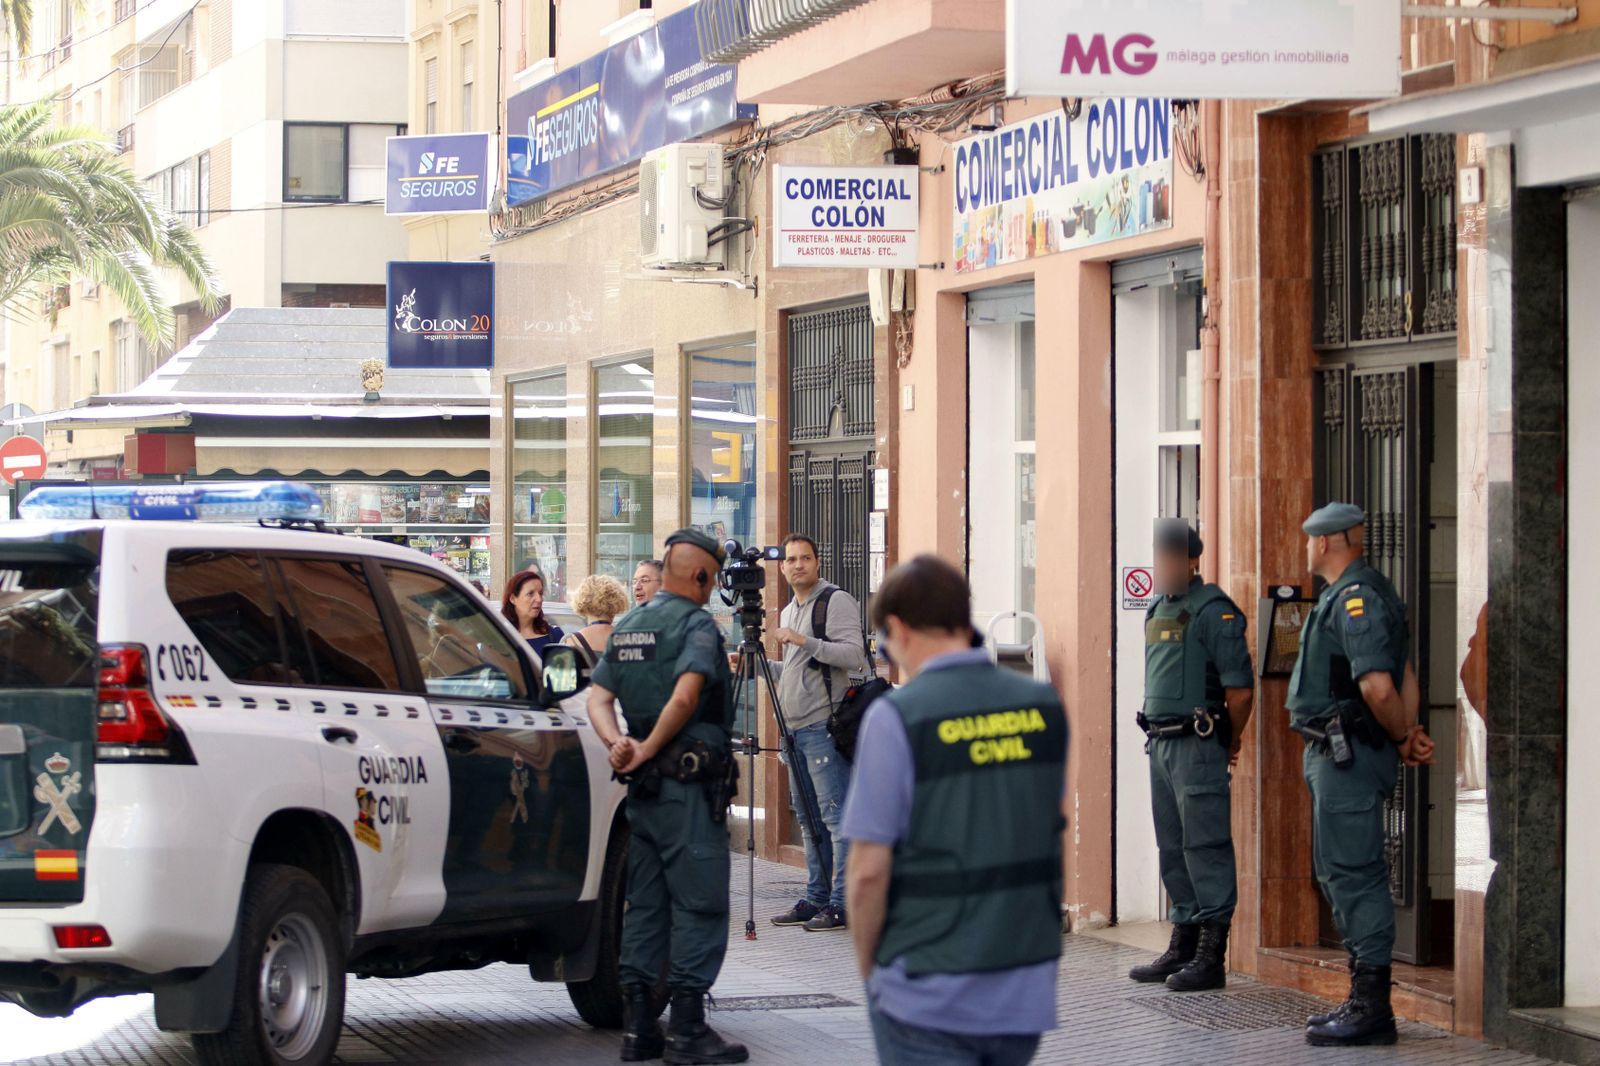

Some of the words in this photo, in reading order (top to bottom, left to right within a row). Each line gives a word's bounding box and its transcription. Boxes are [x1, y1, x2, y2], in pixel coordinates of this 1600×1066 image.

[1060, 33, 1158, 75] MG
[1166, 49, 1216, 64] málaga
[1221, 49, 1270, 65] gestión
[1274, 49, 1350, 64] inmobiliaria
[956, 114, 1079, 214] COMERCIAL
[1086, 97, 1169, 179] COLON
[400, 180, 477, 198] SEGUROS
[785, 178, 911, 200] COMERCIAL
[811, 200, 885, 227] COLÓN
[788, 234, 829, 243] FERRETERIA
[834, 234, 862, 243] MENAJE
[867, 234, 906, 243] DROGUERIA
[797, 247, 834, 256] PLASTICOS
[839, 247, 871, 256] MALETAS
[408, 316, 467, 331] COLON
[470, 315, 490, 331] 20
[613, 632, 656, 646] GUARDIA
[168, 644, 208, 682] 062
[618, 648, 645, 661] CIVIL
[937, 708, 1047, 744] GUARDIA
[969, 735, 1032, 765] CIVIL
[358, 756, 428, 784] GUARDIA
[378, 796, 411, 824] CIVIL
